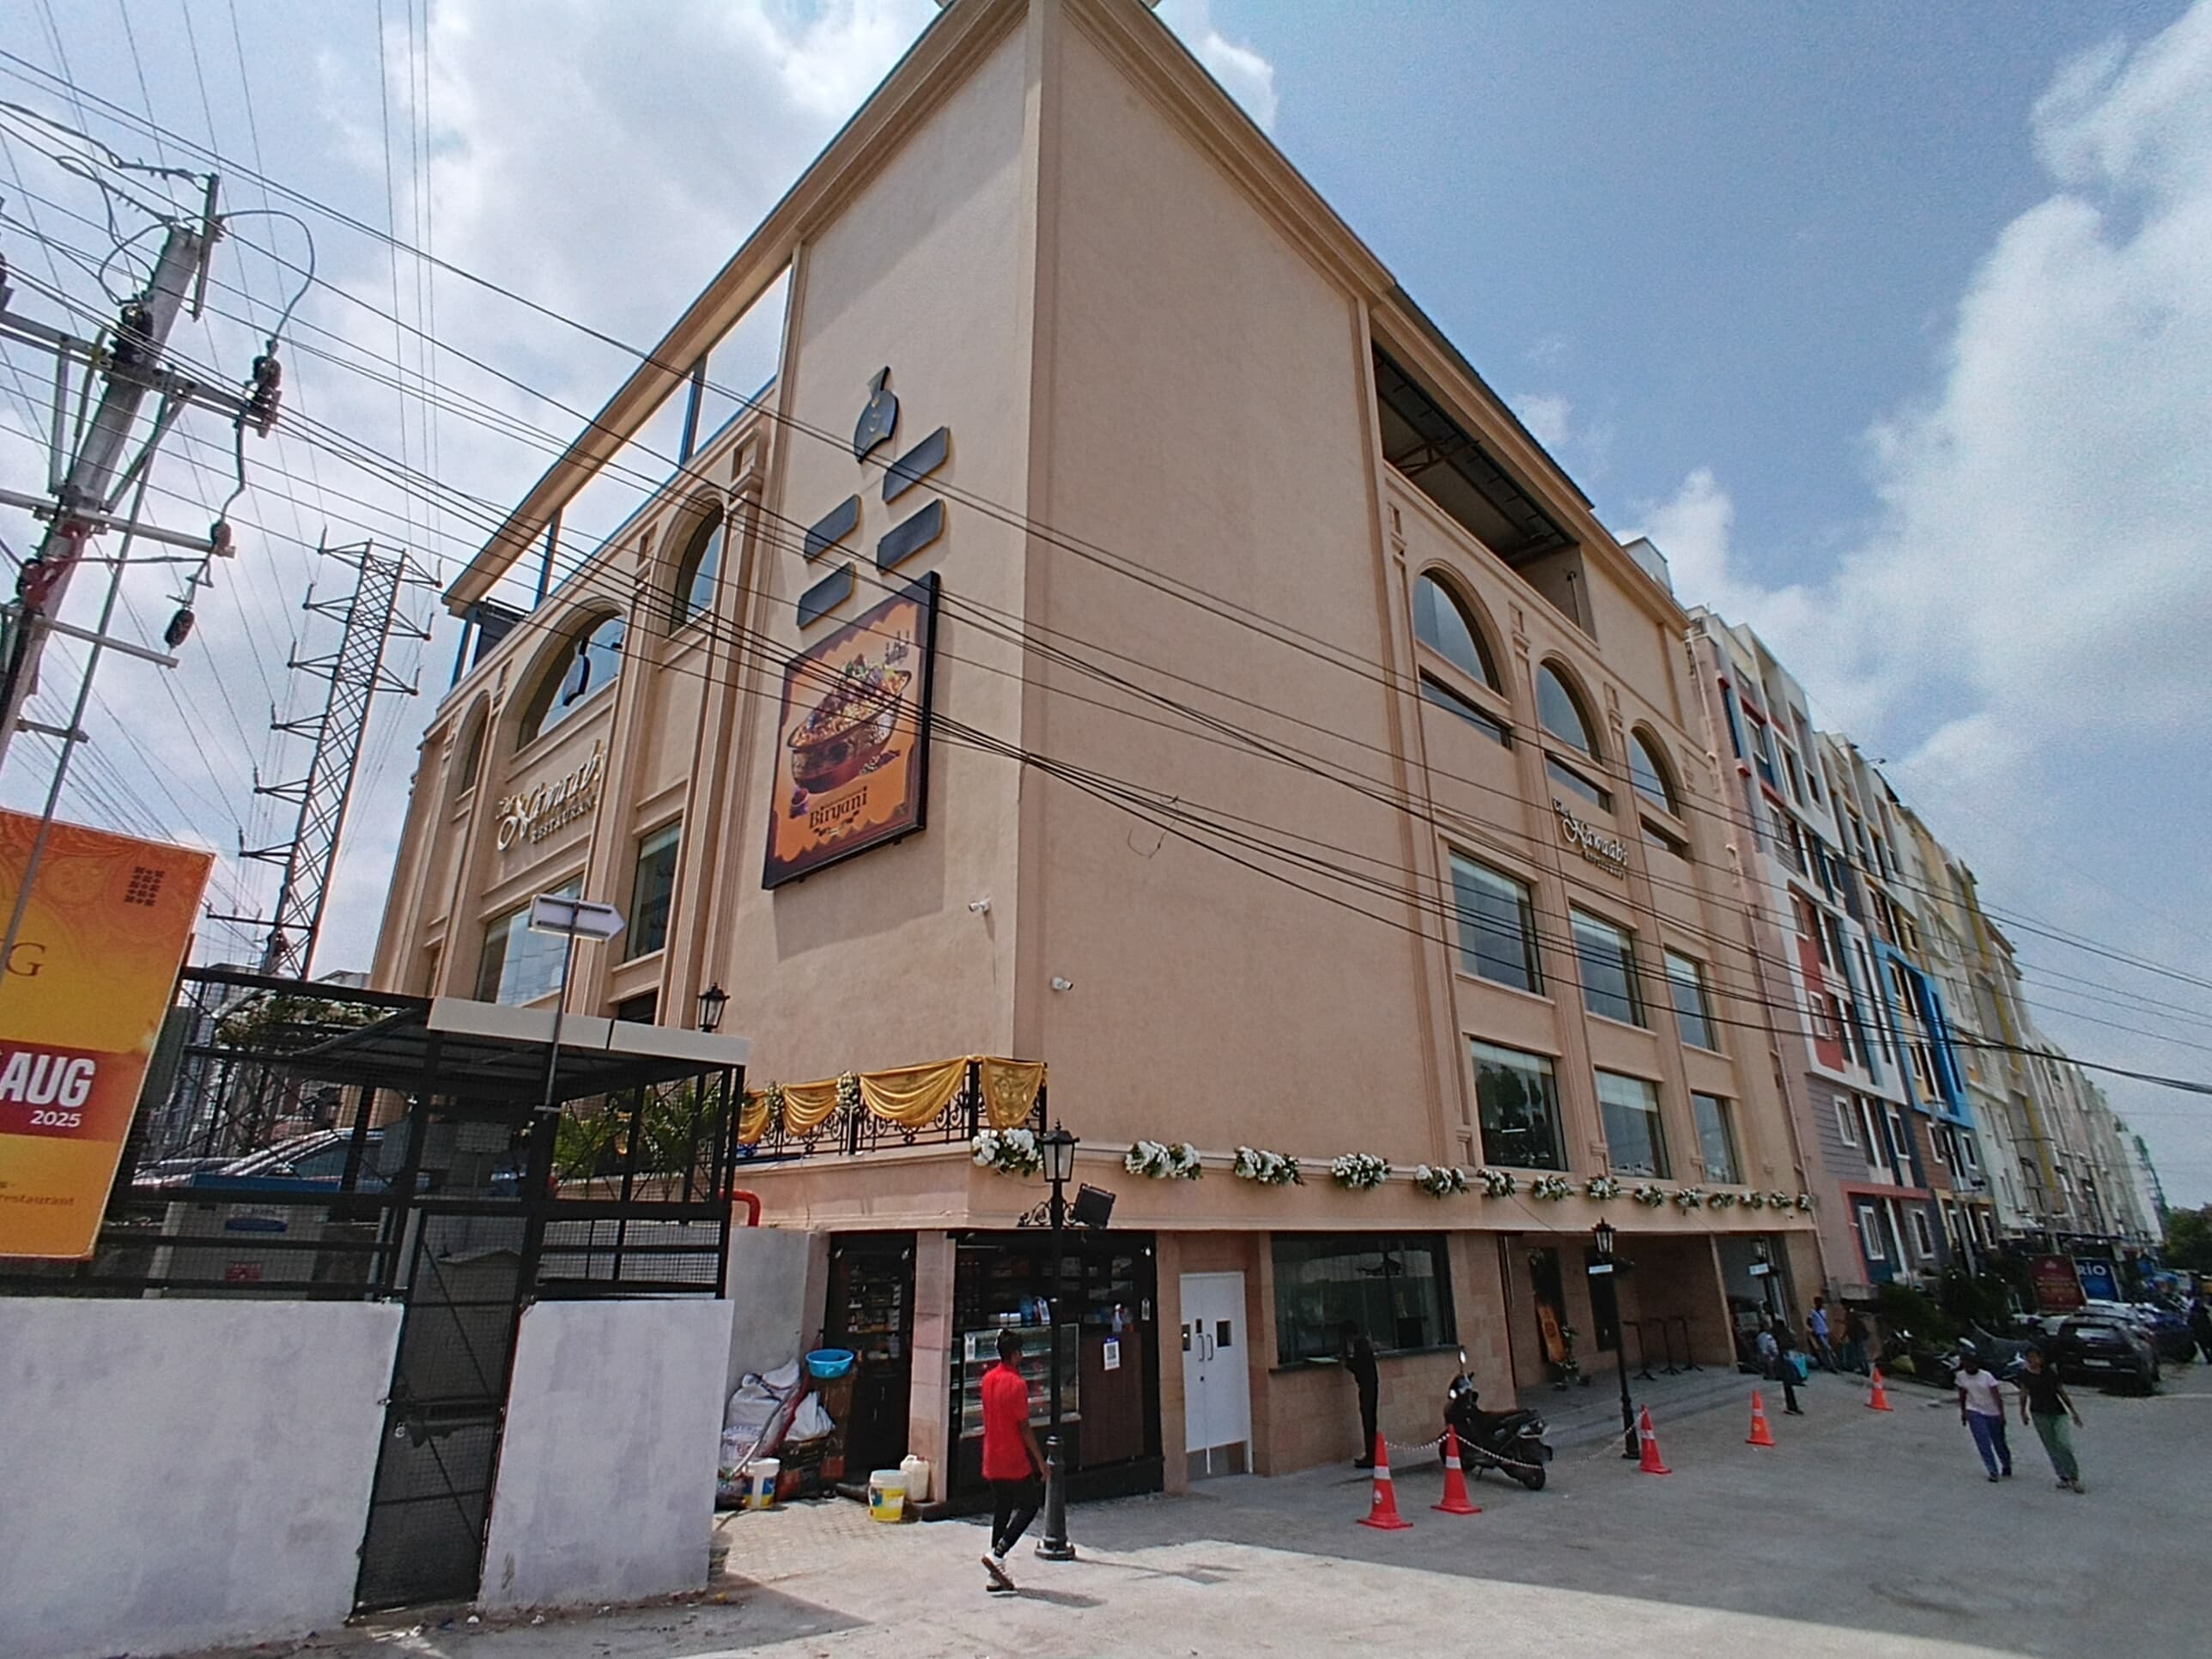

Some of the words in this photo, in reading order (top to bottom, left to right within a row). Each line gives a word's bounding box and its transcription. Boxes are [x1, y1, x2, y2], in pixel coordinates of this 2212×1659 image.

[810, 786, 867, 830] Biryani
[0, 1051, 96, 1108] AUG
[30, 1110, 82, 1127] 2025
